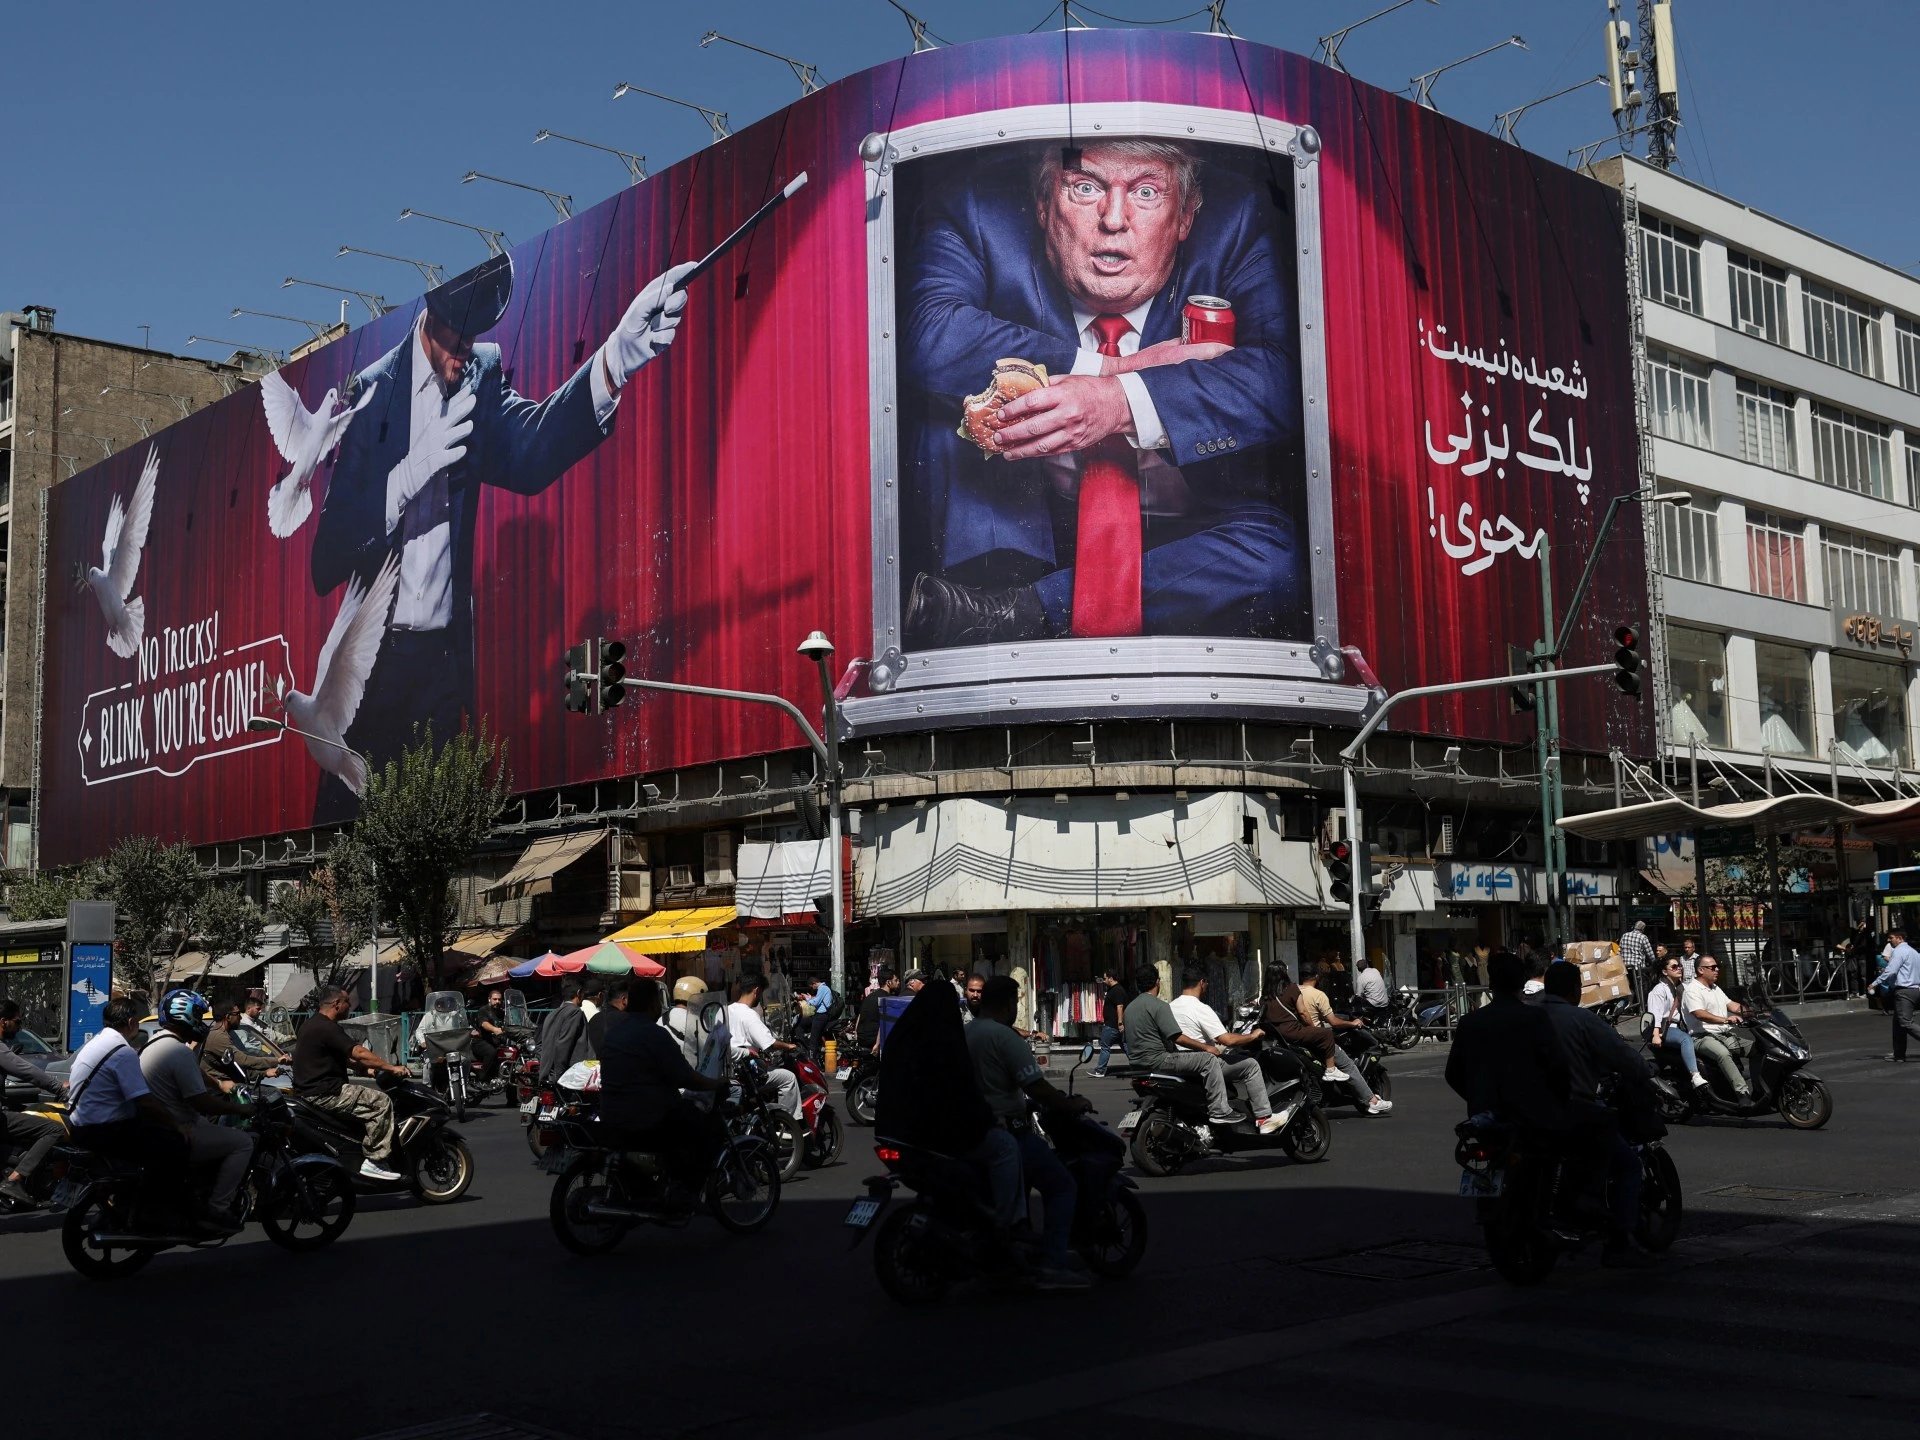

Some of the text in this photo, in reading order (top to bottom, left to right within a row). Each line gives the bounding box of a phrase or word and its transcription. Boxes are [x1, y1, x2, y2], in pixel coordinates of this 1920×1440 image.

[1511, 355, 1588, 400] شعبده
[1425, 391, 1593, 505] پلک بزنی
[138, 609, 219, 685] NO TRICKS!
[100, 694, 150, 769] BLINK,
[153, 677, 207, 755] YOU'RE
